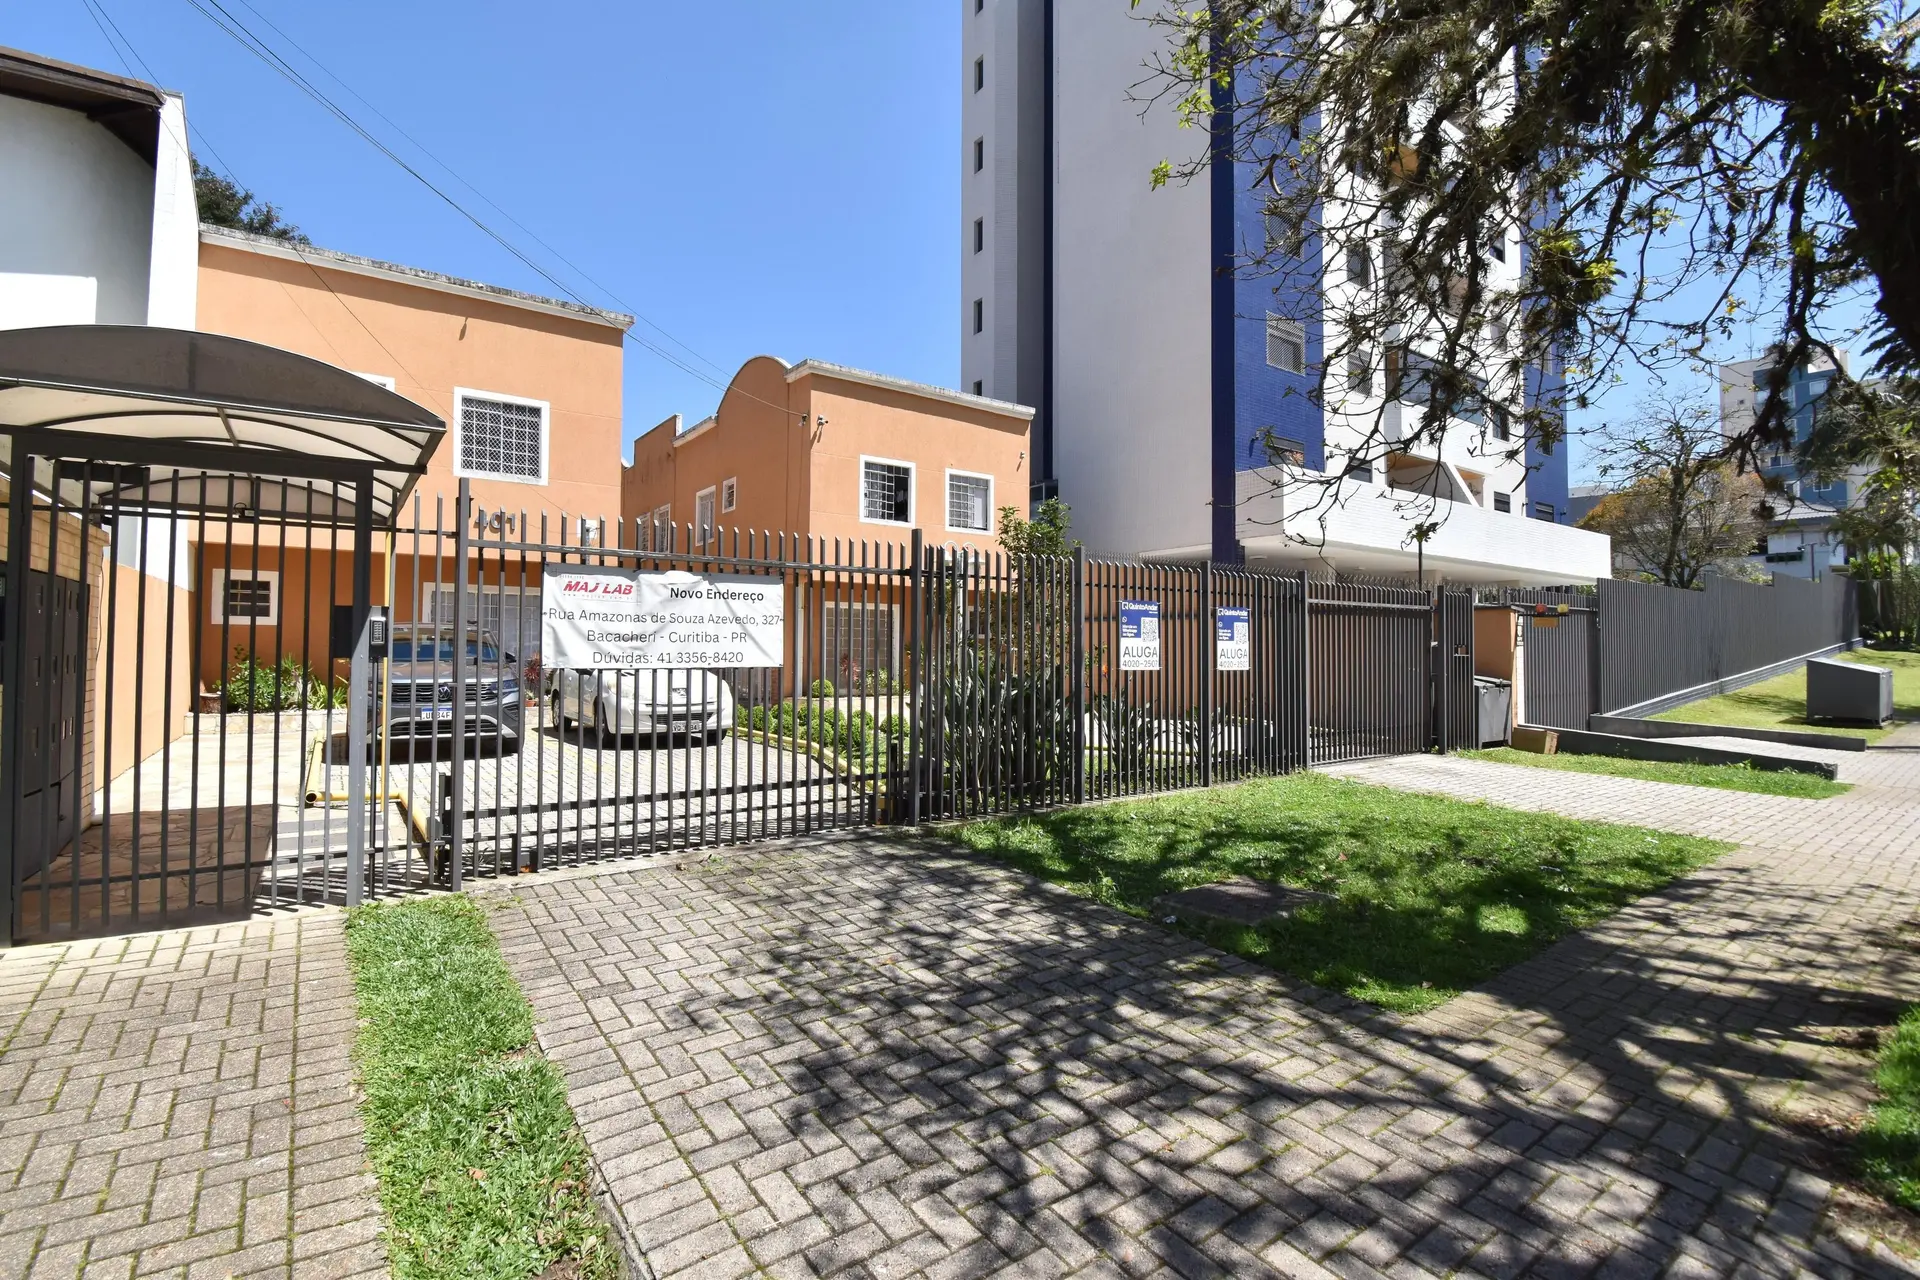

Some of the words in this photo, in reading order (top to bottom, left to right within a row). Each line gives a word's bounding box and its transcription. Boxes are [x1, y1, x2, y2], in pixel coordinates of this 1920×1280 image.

[563, 581, 600, 593] MAJ
[602, 583, 634, 595] LAB
[670, 587, 703, 599] Novo
[706, 588, 764, 604] Endereço
[548, 608, 575, 620] Rua
[579, 609, 647, 623] Amazonas
[650, 612, 666, 623] de
[669, 612, 704, 624] Souza
[707, 613, 759, 626] Azevedo,
[587, 630, 657, 643] Bacacheri
[668, 631, 720, 643] Curitiba
[731, 632, 748, 643] PR
[593, 651, 653, 664] Dúvidas:
[656, 652, 673, 664] 41
[676, 651, 744, 664] 3356-8420
[1122, 646, 1158, 658] ALUGA
[1219, 648, 1248, 660] ALUGA
